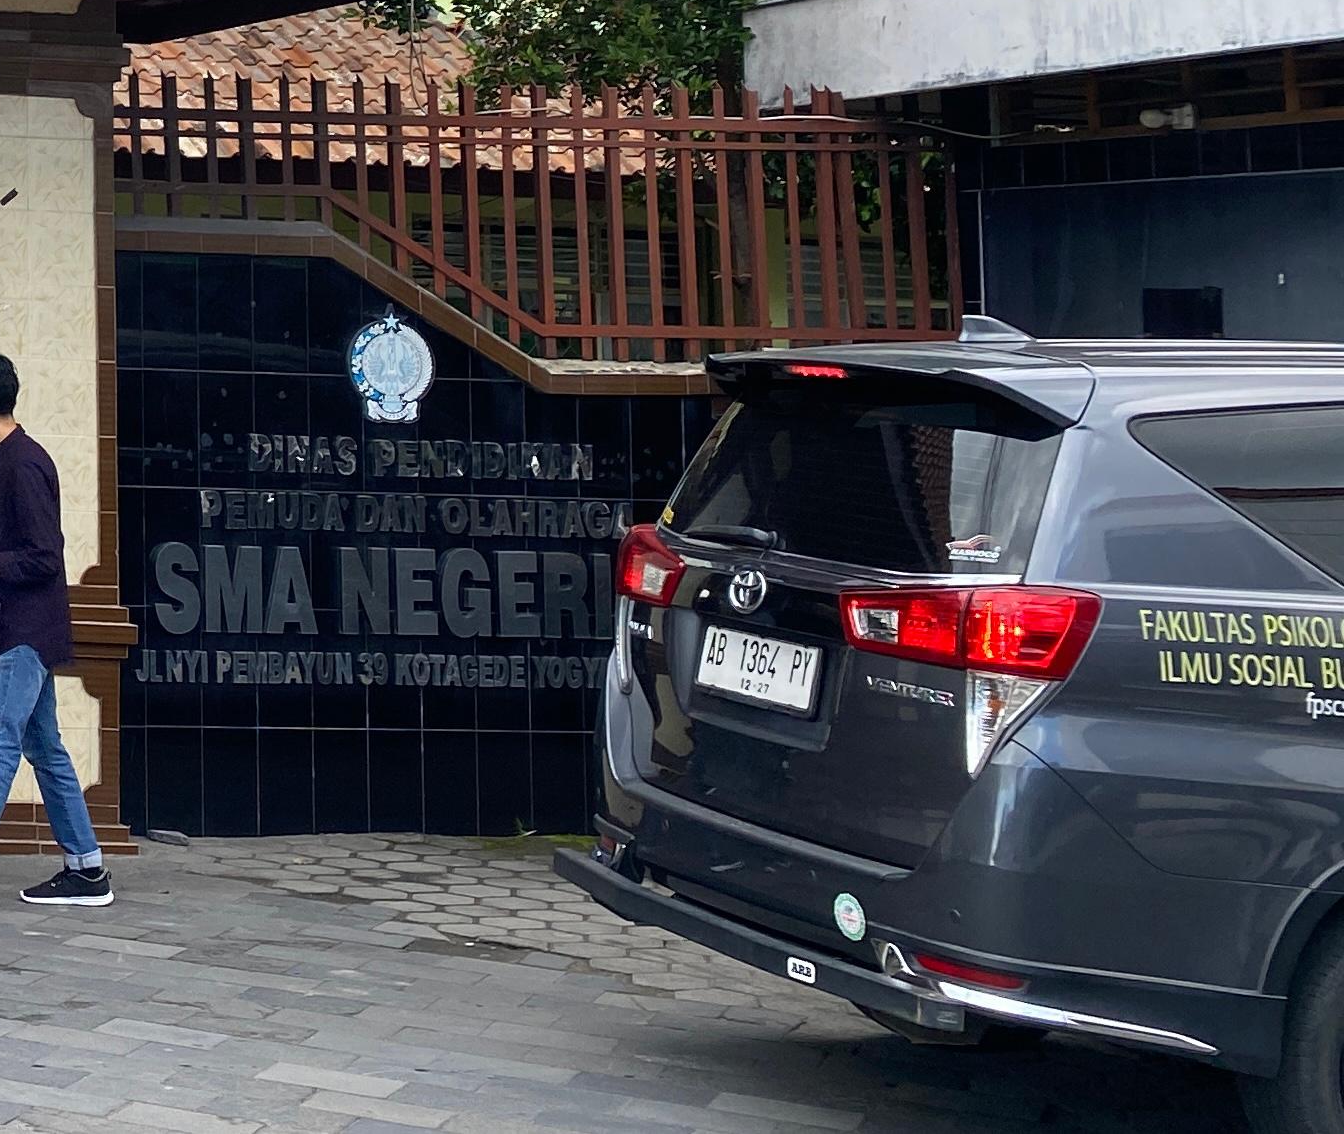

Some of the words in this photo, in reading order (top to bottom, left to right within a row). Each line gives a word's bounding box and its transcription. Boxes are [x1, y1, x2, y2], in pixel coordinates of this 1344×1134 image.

[248, 433, 358, 476] DINAS
[370, 439, 594, 482] PENDIDIKAN
[200, 489, 346, 533] PEMUDA
[356, 494, 428, 535] DAN
[441, 498, 633, 539] OLAHRAGA
[151, 541, 319, 635] SMA
[336, 546, 614, 641] NEGERI
[1139, 609, 1257, 645] FAKULTAS
[1263, 614, 1344, 649] PSIKOL
[167, 650, 209, 684] NYI
[215, 650, 354, 685] PEMBAYUN
[358, 652, 388, 685] 39
[395, 653, 527, 689] KOTAGEDE
[706, 632, 728, 667] AB
[740, 638, 782, 679] 1364
[789, 647, 814, 687] PY
[1159, 650, 1223, 685] ILMU
[1228, 653, 1315, 689] SOSIAL
[1306, 691, 1344, 720] fpsc
